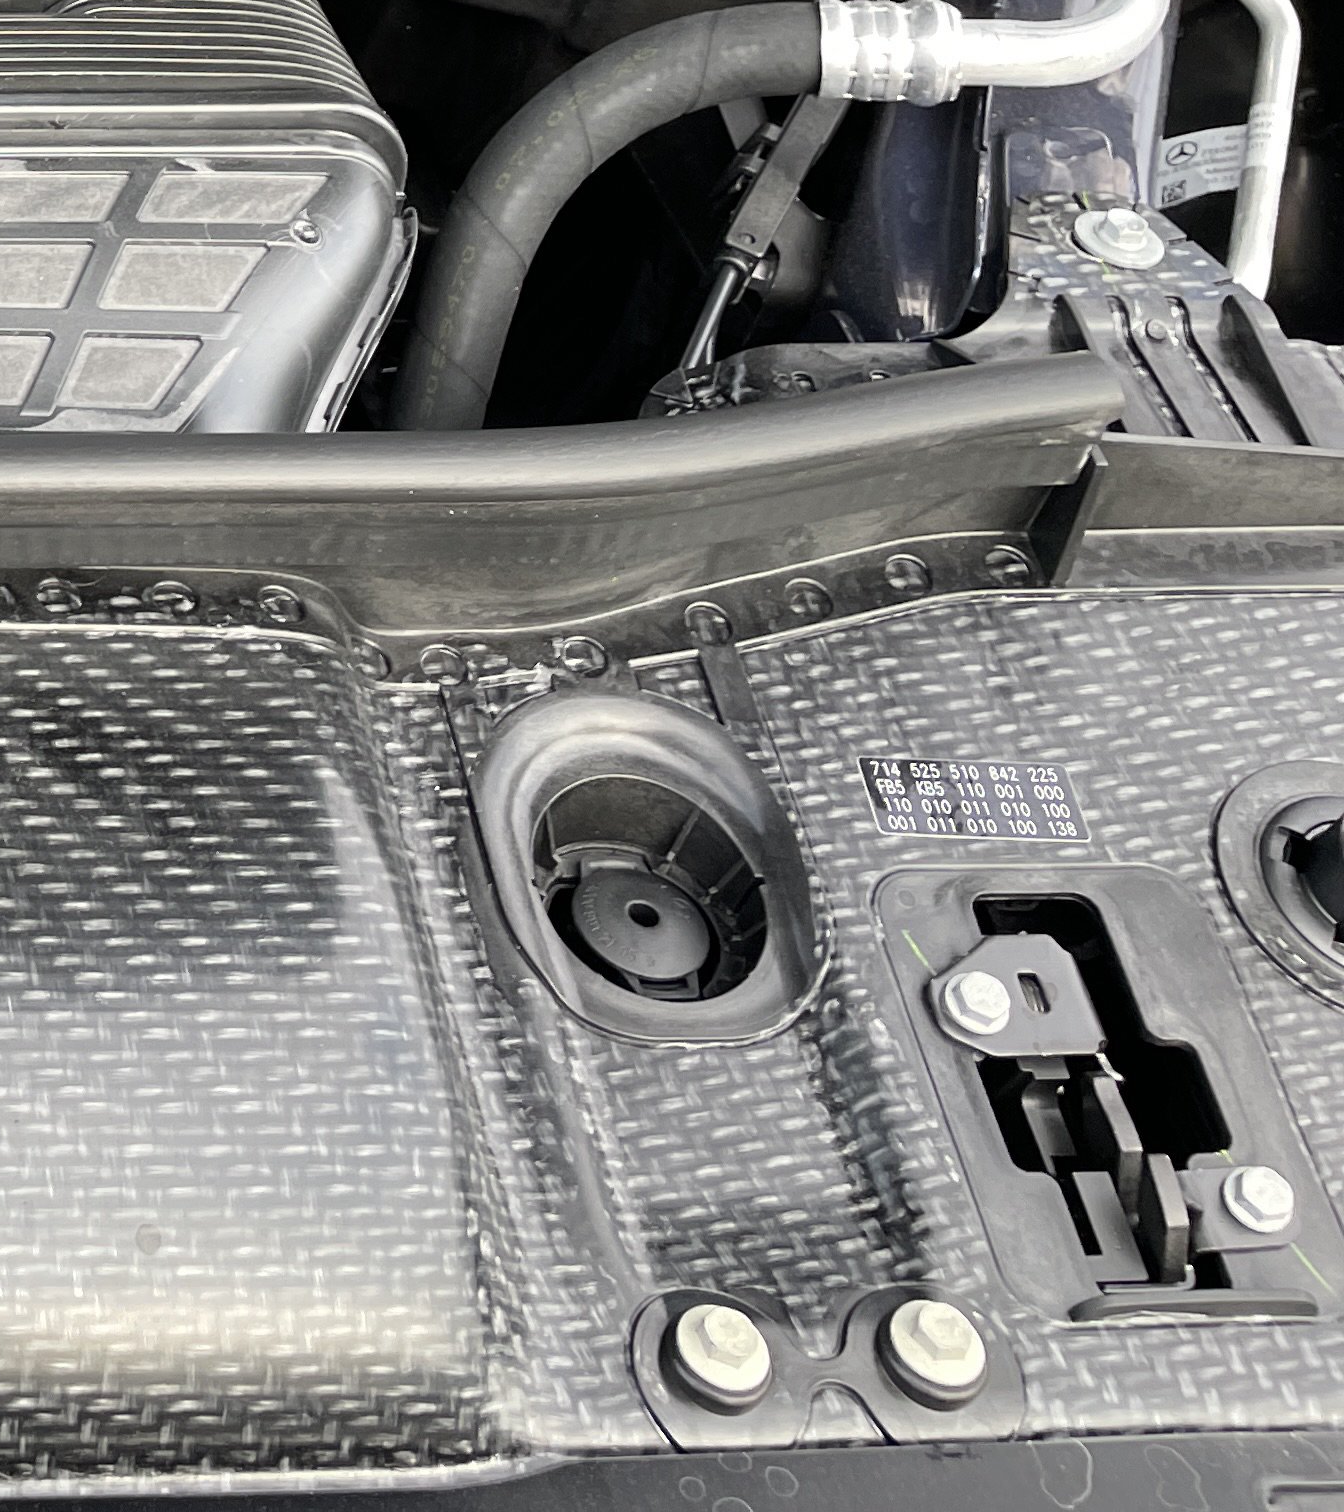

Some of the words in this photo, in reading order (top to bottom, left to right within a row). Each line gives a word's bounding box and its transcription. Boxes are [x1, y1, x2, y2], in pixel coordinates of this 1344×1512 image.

[870, 760, 901, 777] 714
[909, 762, 941, 779] 525
[949, 764, 979, 780] 510
[988, 765, 1019, 781] 842
[1027, 767, 1058, 783] 225
[875, 778, 906, 795] FB5
[915, 780, 945, 797] KB5
[957, 782, 986, 798] 110
[994, 783, 1024, 799] 001
[1033, 784, 1065, 801] 000
[883, 797, 912, 813] 110
[921, 798, 952, 815] 010
[961, 799, 991, 816] 011
[1000, 801, 1031, 818] 010
[1041, 802, 1071, 819] 100
[887, 814, 917, 831] 001
[927, 816, 957, 833] 011
[966, 817, 998, 834] 010
[1008, 819, 1038, 836] 100
[1048, 820, 1078, 837] 138
